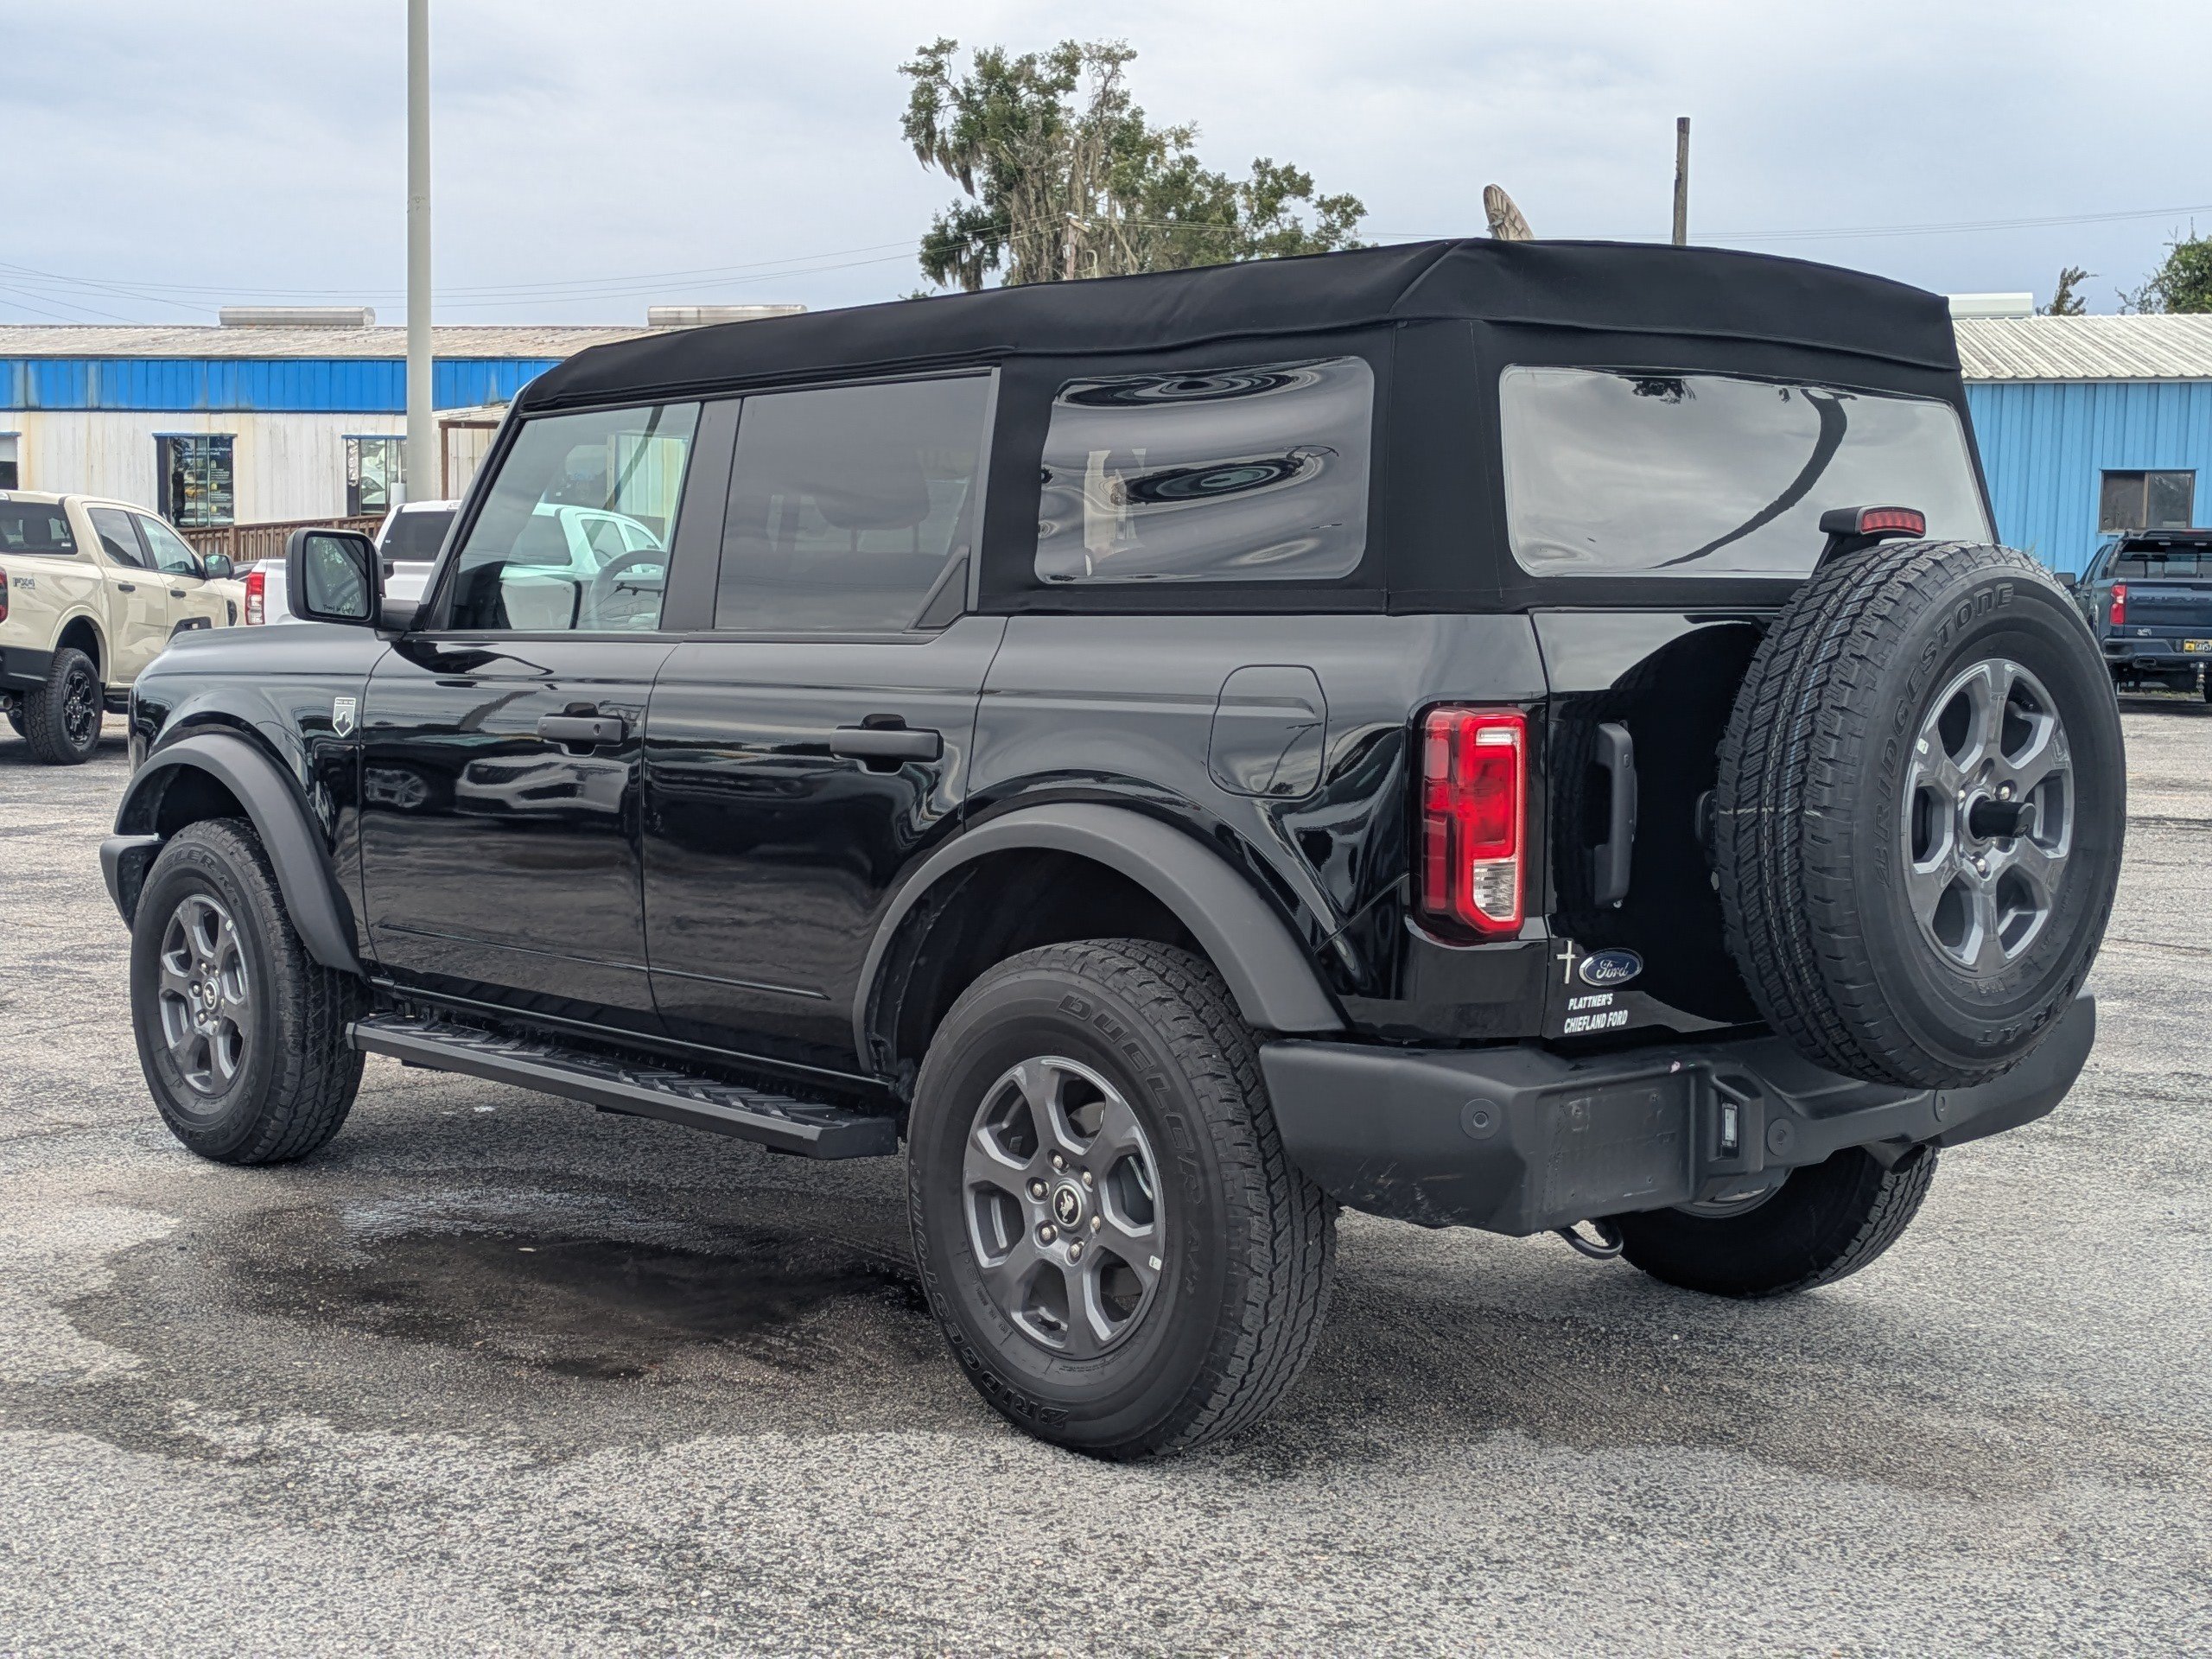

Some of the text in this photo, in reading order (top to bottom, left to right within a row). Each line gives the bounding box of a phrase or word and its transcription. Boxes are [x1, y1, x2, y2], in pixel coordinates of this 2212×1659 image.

[1873, 582, 2015, 889] BRIDGESTONE
[1595, 958, 1630, 980] Ford
[1567, 993, 1614, 1011] PLATTNER'S
[1563, 1009, 1629, 1034] CHIEFLAND FORD
